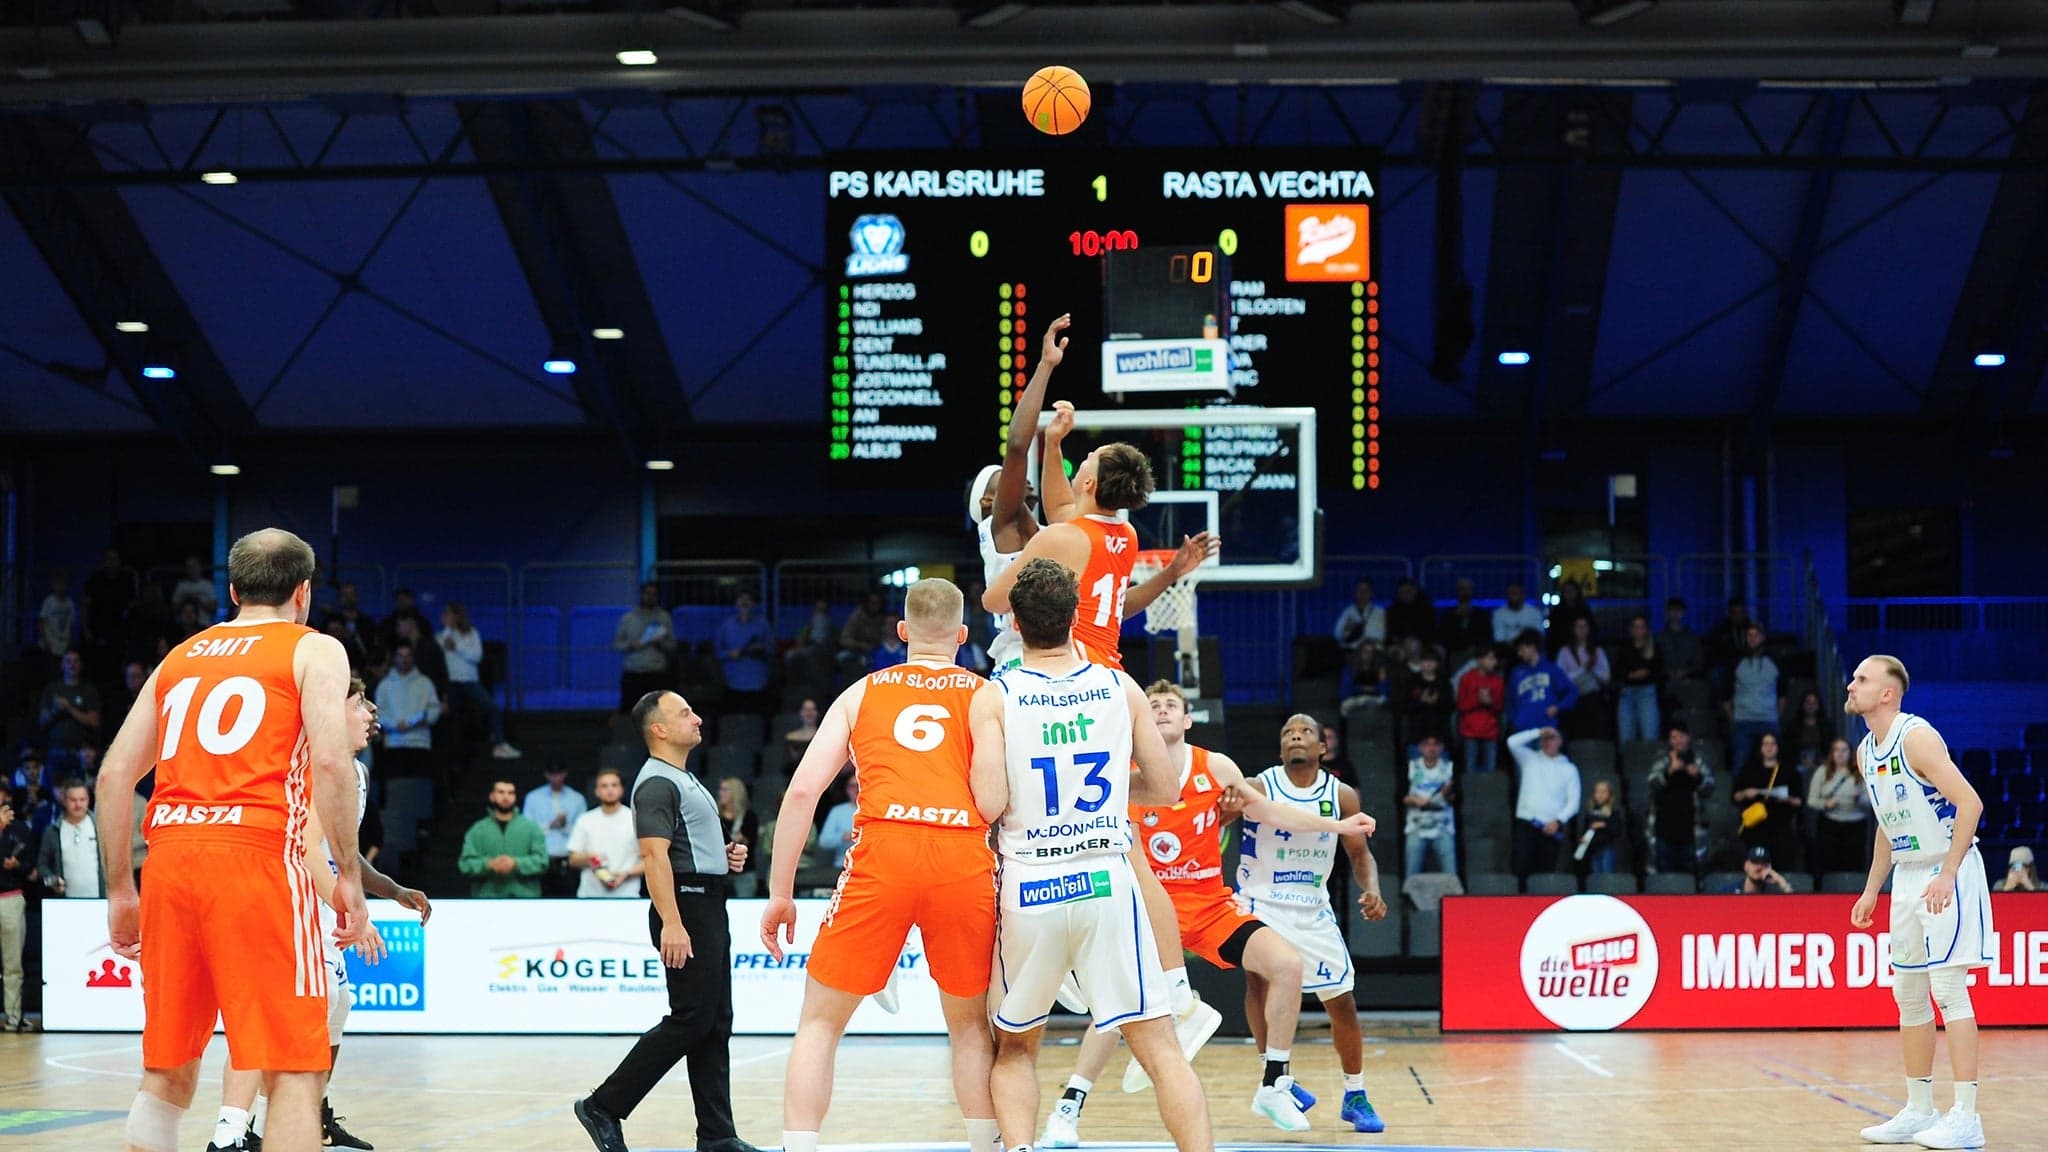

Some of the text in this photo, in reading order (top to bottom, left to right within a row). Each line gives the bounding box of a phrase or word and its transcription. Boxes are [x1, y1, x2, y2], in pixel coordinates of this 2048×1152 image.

[829, 169, 1045, 198] PS KARLSRUHE
[1091, 175, 1107, 202] 1
[1163, 171, 1374, 199] RASTA VECHTA
[970, 230, 989, 257] 0
[1068, 229, 1139, 257] 10:00
[1219, 228, 1238, 256] 0
[1190, 251, 1214, 284] 0
[1230, 281, 1266, 297] RAM
[1235, 298, 1306, 314] SLOOTEN
[852, 318, 924, 335] WILLIAMS
[1118, 348, 1191, 372] wohlfeil
[852, 389, 944, 406] MCDONNELL
[186, 636, 263, 658] SMIT
[871, 671, 978, 690] VAN SLOOTEN
[1018, 688, 1112, 707] KARLSRUHE
[161, 676, 266, 761] 10
[893, 704, 952, 752] 6
[1042, 712, 1095, 746] init
[1031, 751, 1112, 816] 13
[152, 804, 244, 828] RASTA
[885, 804, 969, 826] RASTA
[1036, 838, 1111, 858] BRUKER
[1023, 874, 1087, 903] wohlfeil
[1274, 871, 1314, 883] wohlfeil
[734, 953, 809, 969] PFEIFF
[1541, 937, 1636, 973] die neue
[1682, 933, 1834, 989] IMMER
[1317, 962, 1331, 980] 4
[1538, 966, 1630, 998] welle
